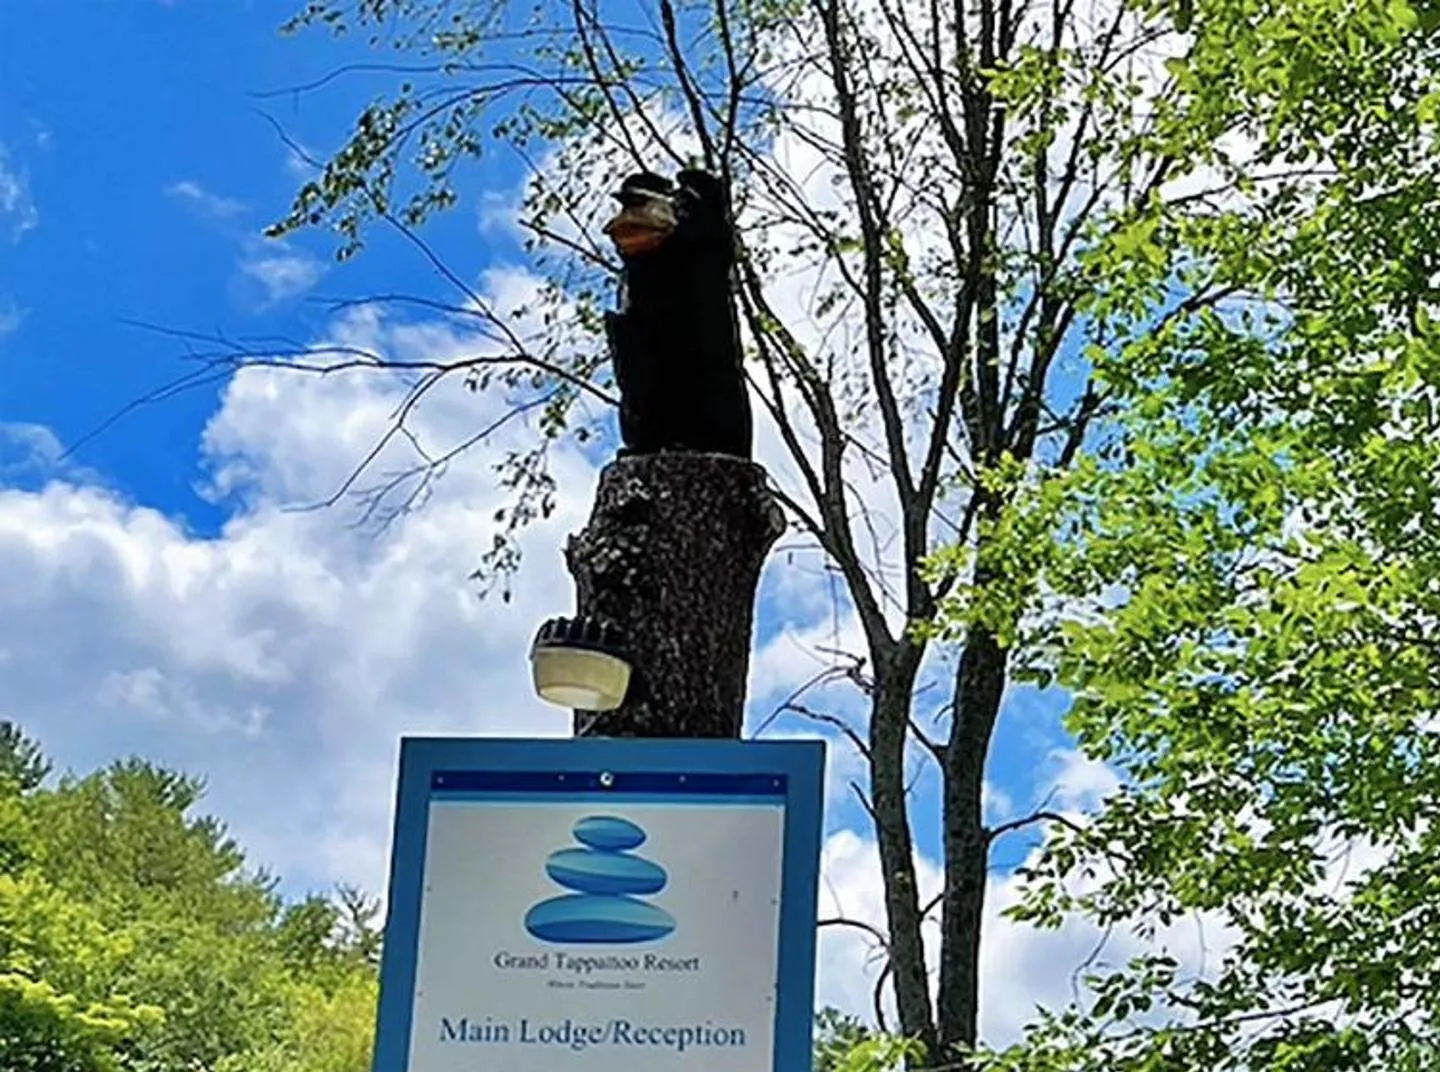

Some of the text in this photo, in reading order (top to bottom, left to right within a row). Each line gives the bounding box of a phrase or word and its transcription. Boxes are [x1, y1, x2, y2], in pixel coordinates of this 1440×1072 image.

[494, 952, 548, 970] Grand
[643, 953, 700, 971] Resort
[440, 1017, 746, 1051] Main Lodge/Reception
